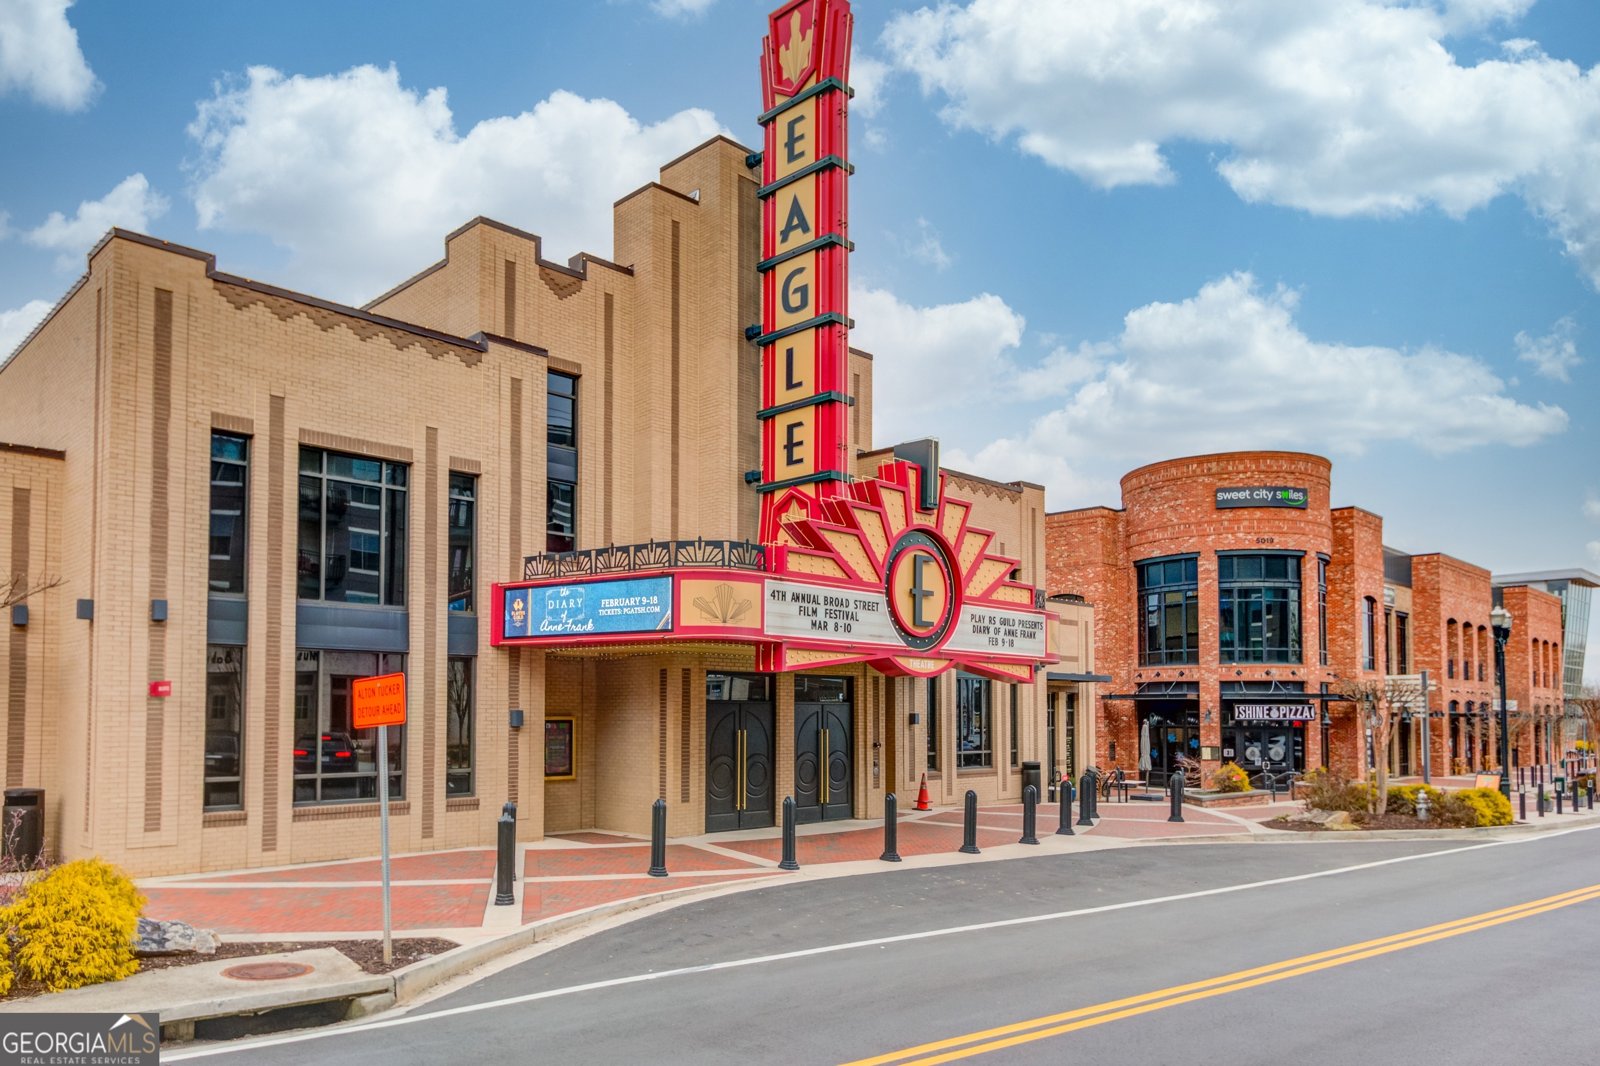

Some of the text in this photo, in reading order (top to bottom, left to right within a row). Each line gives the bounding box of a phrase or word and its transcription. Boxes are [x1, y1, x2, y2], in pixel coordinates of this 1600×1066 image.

[780, 114, 811, 467] EAGLE
[1217, 489, 1250, 500] sweet
[1253, 489, 1273, 501] city
[560, 586, 570, 597] the
[909, 554, 935, 627] E
[548, 598, 583, 609] DIARY
[601, 595, 658, 607] FEBRUARY 9-18
[770, 589, 879, 612] 4TH ANNUAL BROAD STREET
[561, 610, 568, 623] of
[598, 608, 622, 616] TICKETS:
[798, 605, 859, 622] FILM FESTIVAL
[540, 618, 595, 632] Anne Frank
[810, 619, 852, 633] MAR 8-10
[999, 617, 1016, 627] GUILD
[1017, 619, 1043, 630] PRESENTS
[972, 624, 1036, 640] DIARY OF ANNE FRANK
[988, 636, 1015, 648] FEB 9-18
[909, 658, 935, 669] THEATRE
[358, 683, 401, 700] ALTON TUCKER
[358, 702, 402, 718] DETOUR AHEAD
[1239, 706, 1310, 719] SHINE PIZZA
